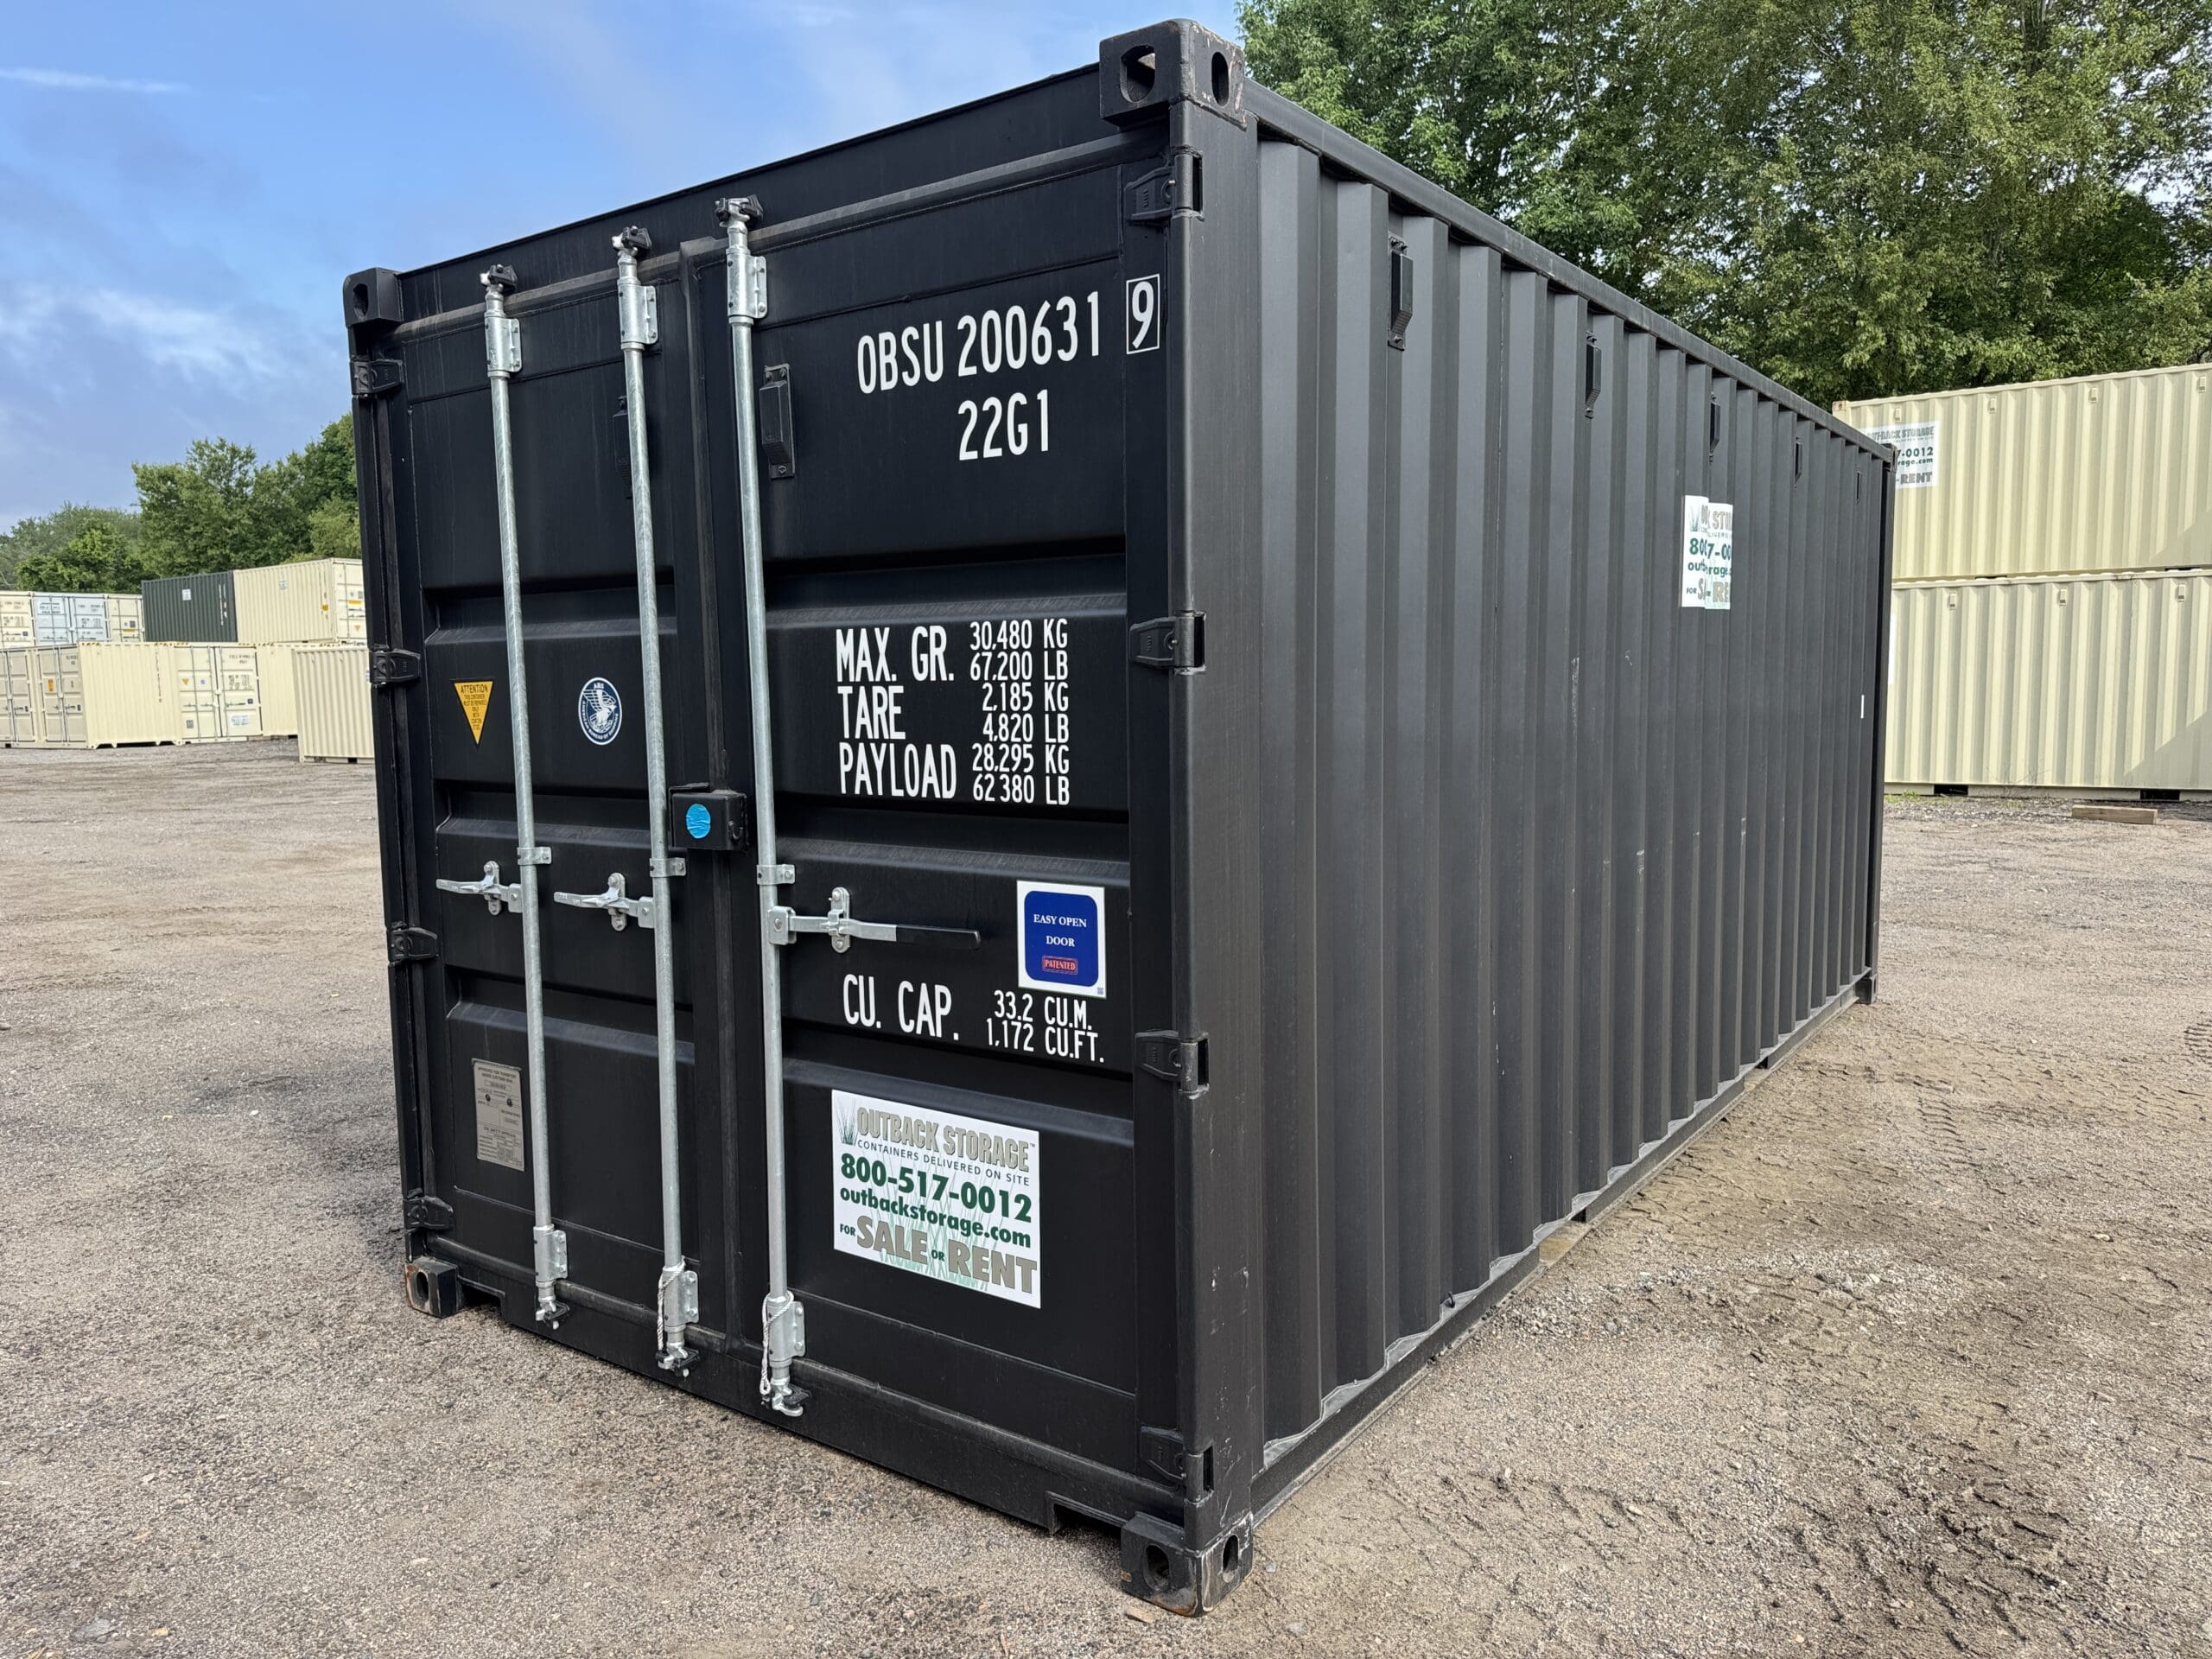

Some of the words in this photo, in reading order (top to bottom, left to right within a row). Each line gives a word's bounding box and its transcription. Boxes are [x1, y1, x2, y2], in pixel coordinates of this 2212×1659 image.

[857, 320, 944, 394] OBSU
[957, 290, 1099, 377] 200631
[1131, 281, 1154, 350] 9
[957, 389, 1049, 461] 22G1
[1900, 471, 1933, 485] RENT
[836, 626, 897, 682] MAX.
[911, 626, 954, 681] GR.
[969, 620, 1033, 650] 30,480
[1043, 619, 1068, 649] KG
[969, 651, 1033, 681] 67,200
[1043, 650, 1068, 681] LB
[461, 683, 488, 694] ATTENTION
[837, 685, 906, 740] TARE
[982, 682, 1033, 711] 2,185
[1044, 682, 1069, 712] KG
[982, 713, 1033, 742] 4,820
[1045, 713, 1070, 743] LB
[839, 741, 957, 799] PAYLOAD
[971, 743, 1034, 772] 28,295
[1045, 744, 1070, 774] KG
[1046, 775, 1071, 805] LB
[1033, 913, 1058, 925] EASY
[1058, 917, 1087, 928] OPEN
[1046, 935, 1076, 947] DOOR
[1044, 959, 1076, 970] PATENTED
[842, 974, 881, 1028] CU.
[898, 980, 959, 1040] CAP.
[994, 989, 1034, 1022] 33.2
[1044, 996, 1092, 1030] CU.M.
[986, 1017, 1034, 1052] 1,172
[1045, 1026, 1105, 1063] CU.FT.
[856, 1107, 939, 1154] OUTBACK
[857, 1139, 918, 1161] CONTAINERS
[924, 1154, 981, 1175] DELIVERED
[986, 1168, 1001, 1179] ON
[1006, 1173, 1030, 1186] SITE
[841, 1153, 1032, 1224] 800-517-0012
[840, 1186, 1031, 1248] outbackstorage.com
[839, 1223, 855, 1237] FOR
[856, 1215, 928, 1265] SALE
[931, 1249, 944, 1262] OR
[948, 1238, 1037, 1294] RENT
